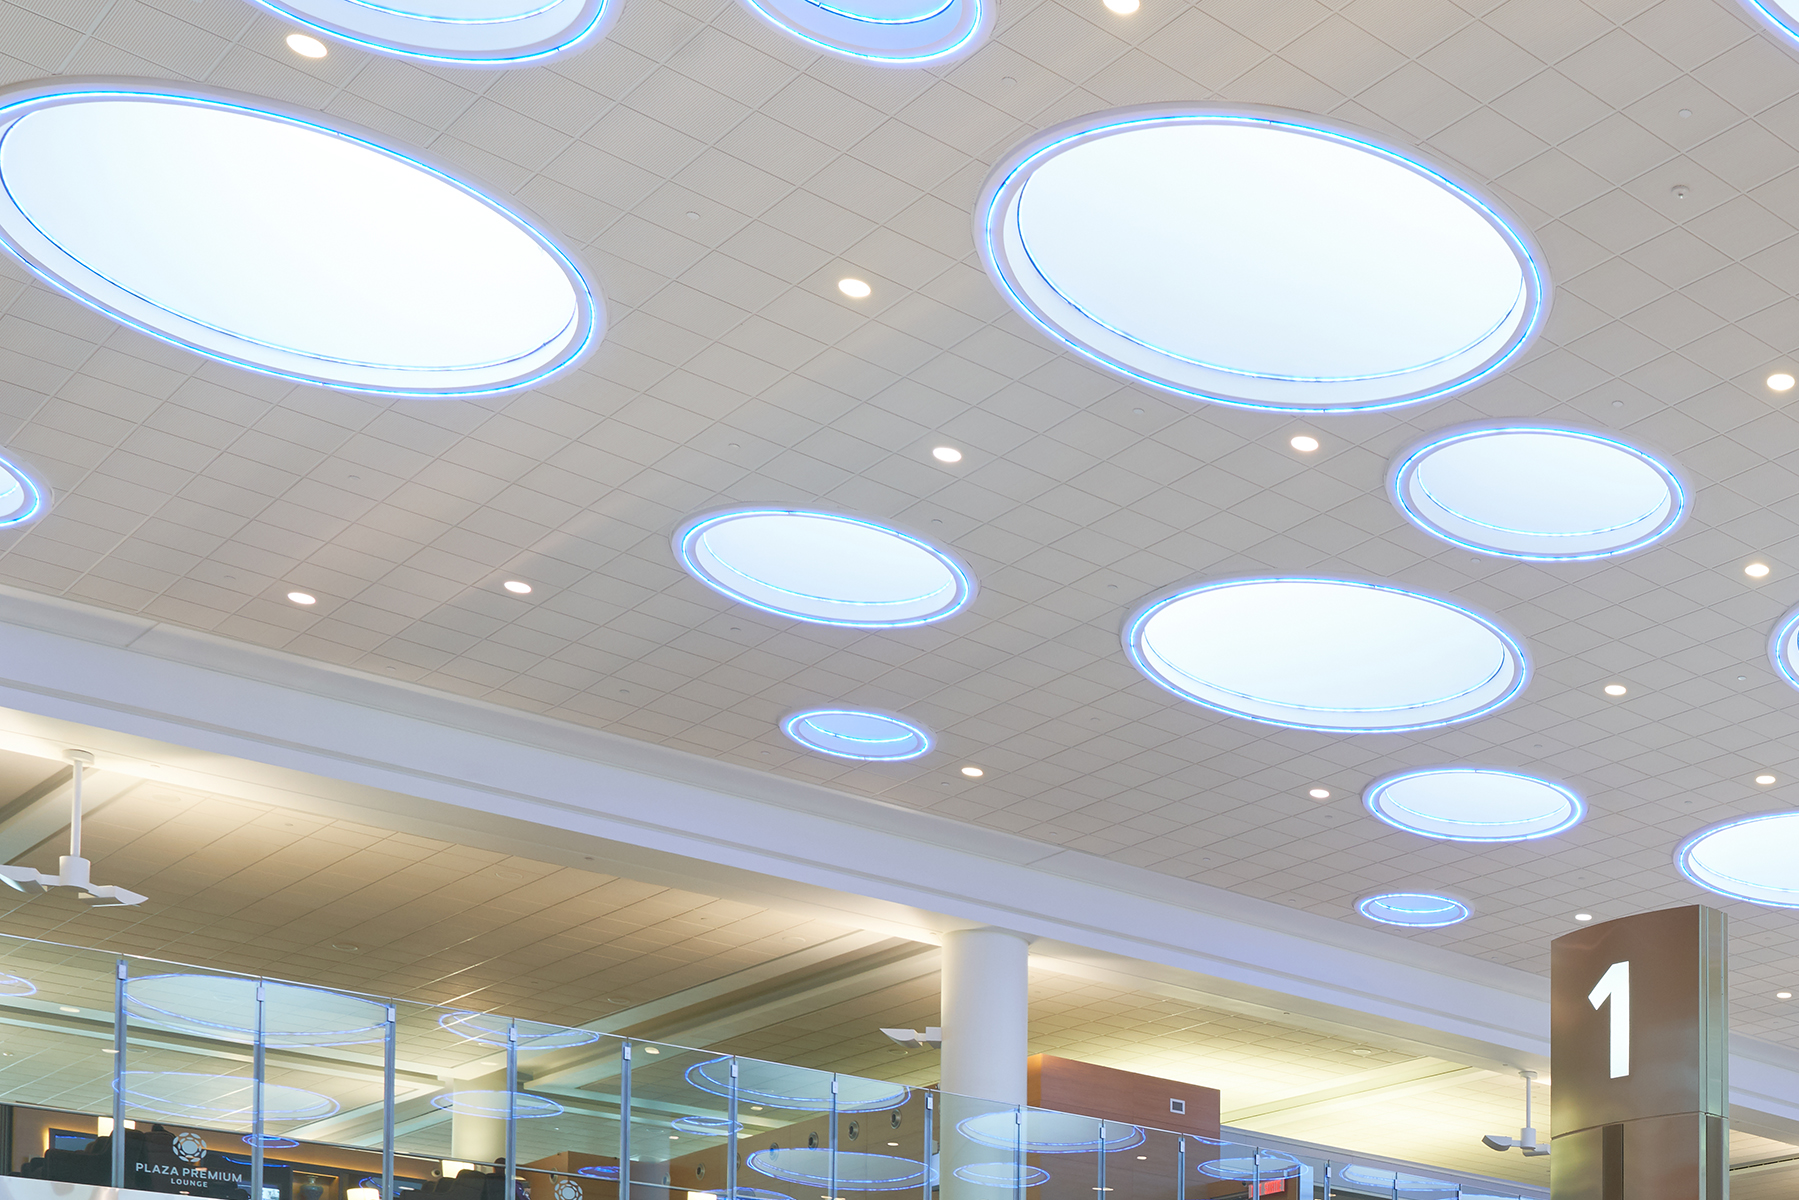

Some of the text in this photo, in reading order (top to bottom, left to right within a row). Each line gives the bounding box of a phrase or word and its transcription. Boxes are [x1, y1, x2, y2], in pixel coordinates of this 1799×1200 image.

[1588, 960, 1630, 1079] 1
[135, 1162, 242, 1182] PLAZA PREMIUM
[171, 1178, 208, 1188] LOUNGE
